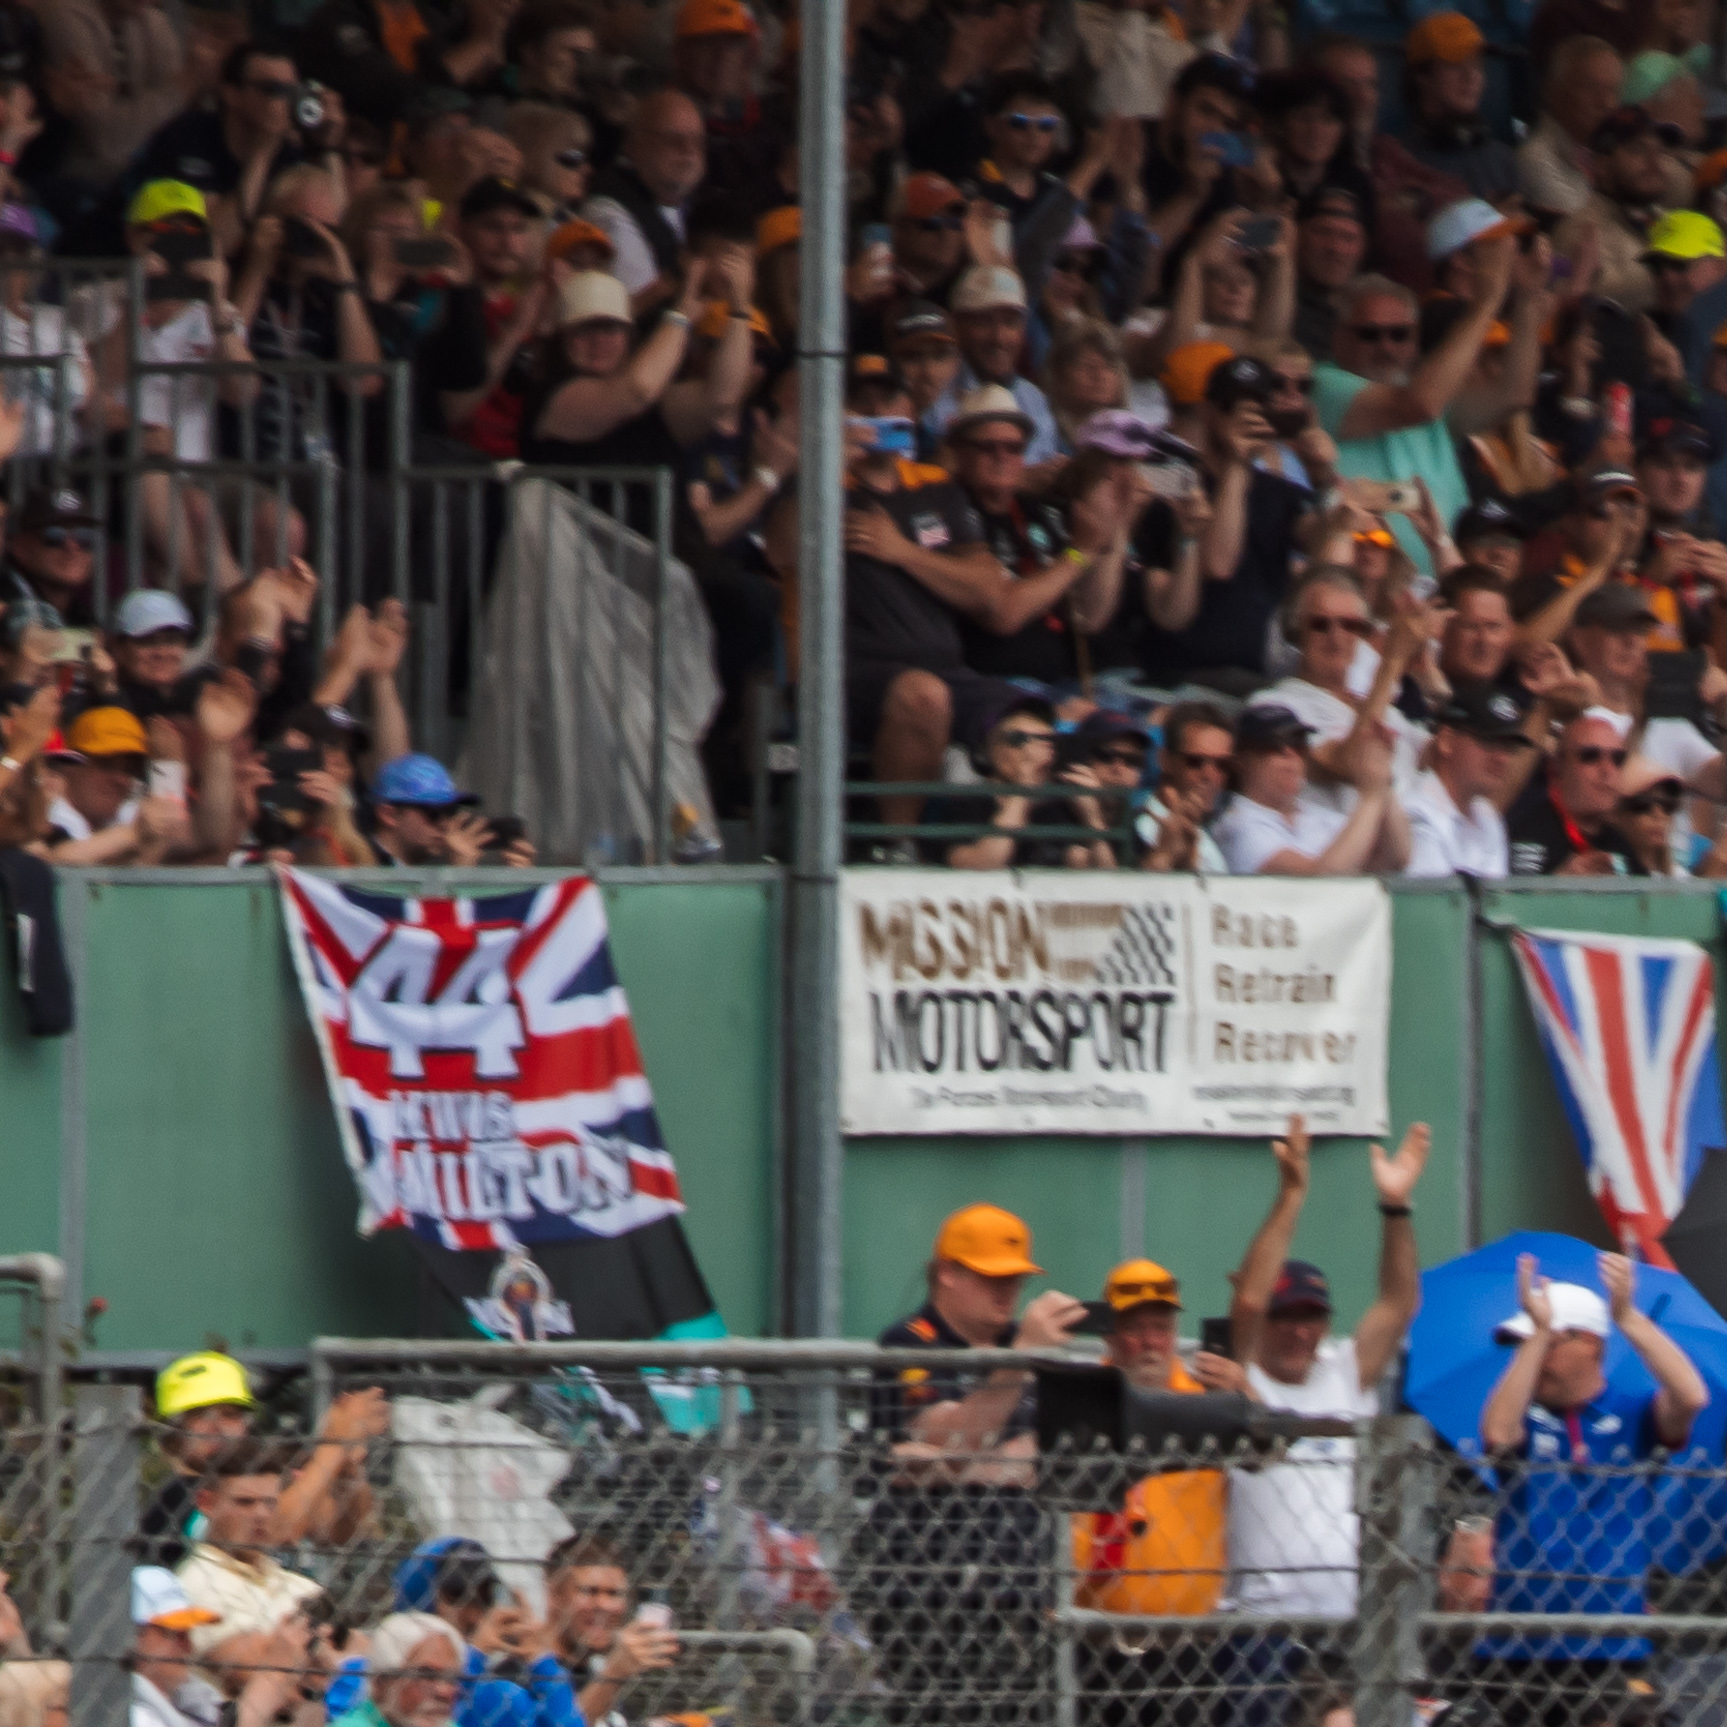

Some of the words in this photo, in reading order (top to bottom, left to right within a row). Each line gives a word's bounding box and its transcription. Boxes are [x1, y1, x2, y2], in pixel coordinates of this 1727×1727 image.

[857, 895, 1053, 982] MISSION
[1211, 903, 1299, 949] Race
[349, 925, 530, 1080] 44
[1213, 962, 1338, 1004] Retrain
[868, 989, 1178, 1074] MOTORSPORT
[1213, 1021, 1358, 1065] Recover
